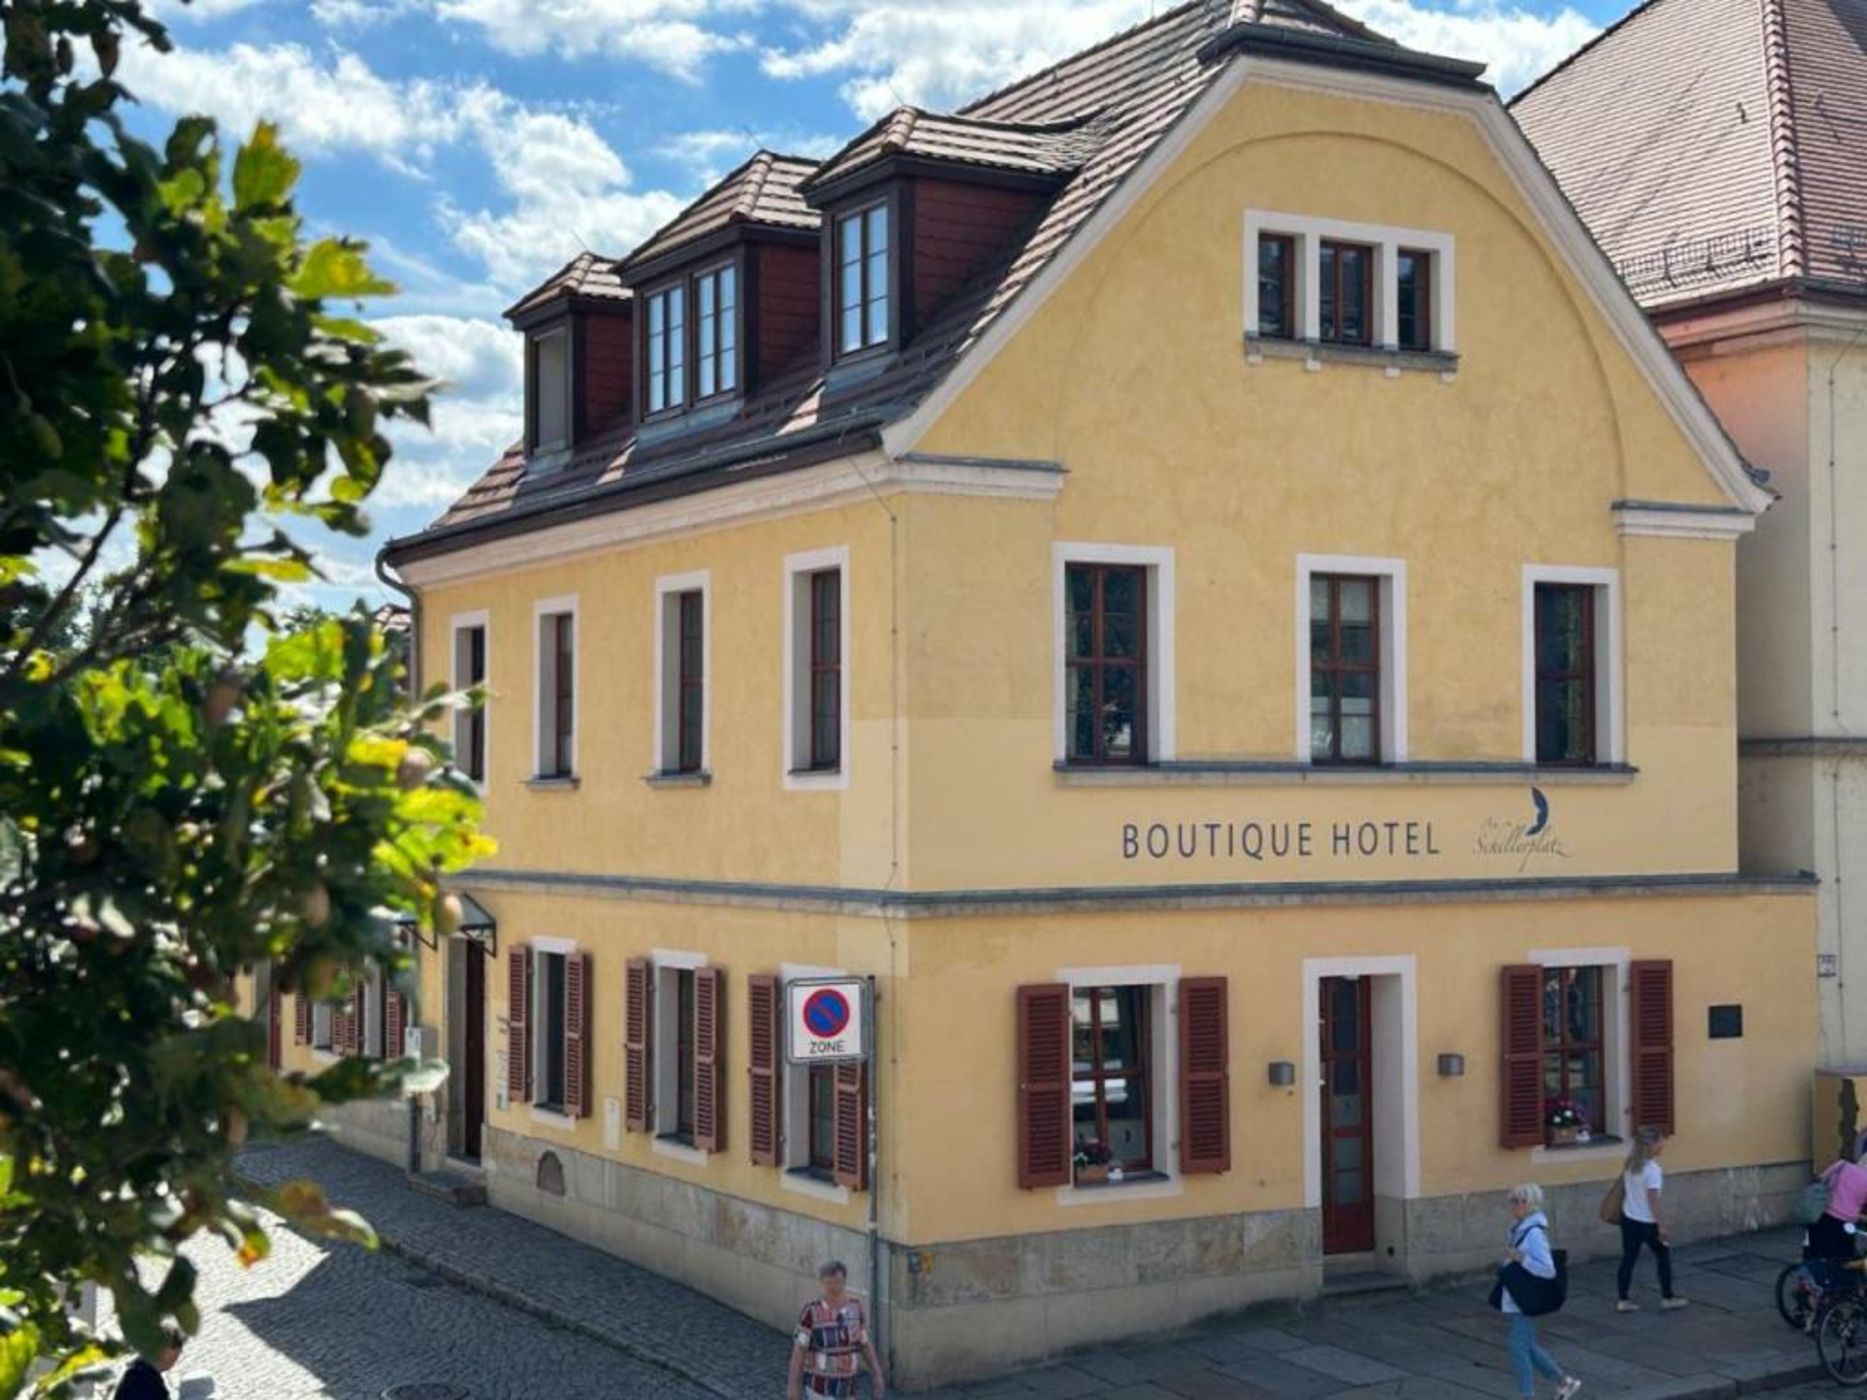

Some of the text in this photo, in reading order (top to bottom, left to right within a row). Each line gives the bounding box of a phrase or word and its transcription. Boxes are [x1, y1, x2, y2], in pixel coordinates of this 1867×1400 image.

[1122, 821, 1440, 861] BOUTIQUE HOTEL
[808, 1040, 846, 1055] ZONE
